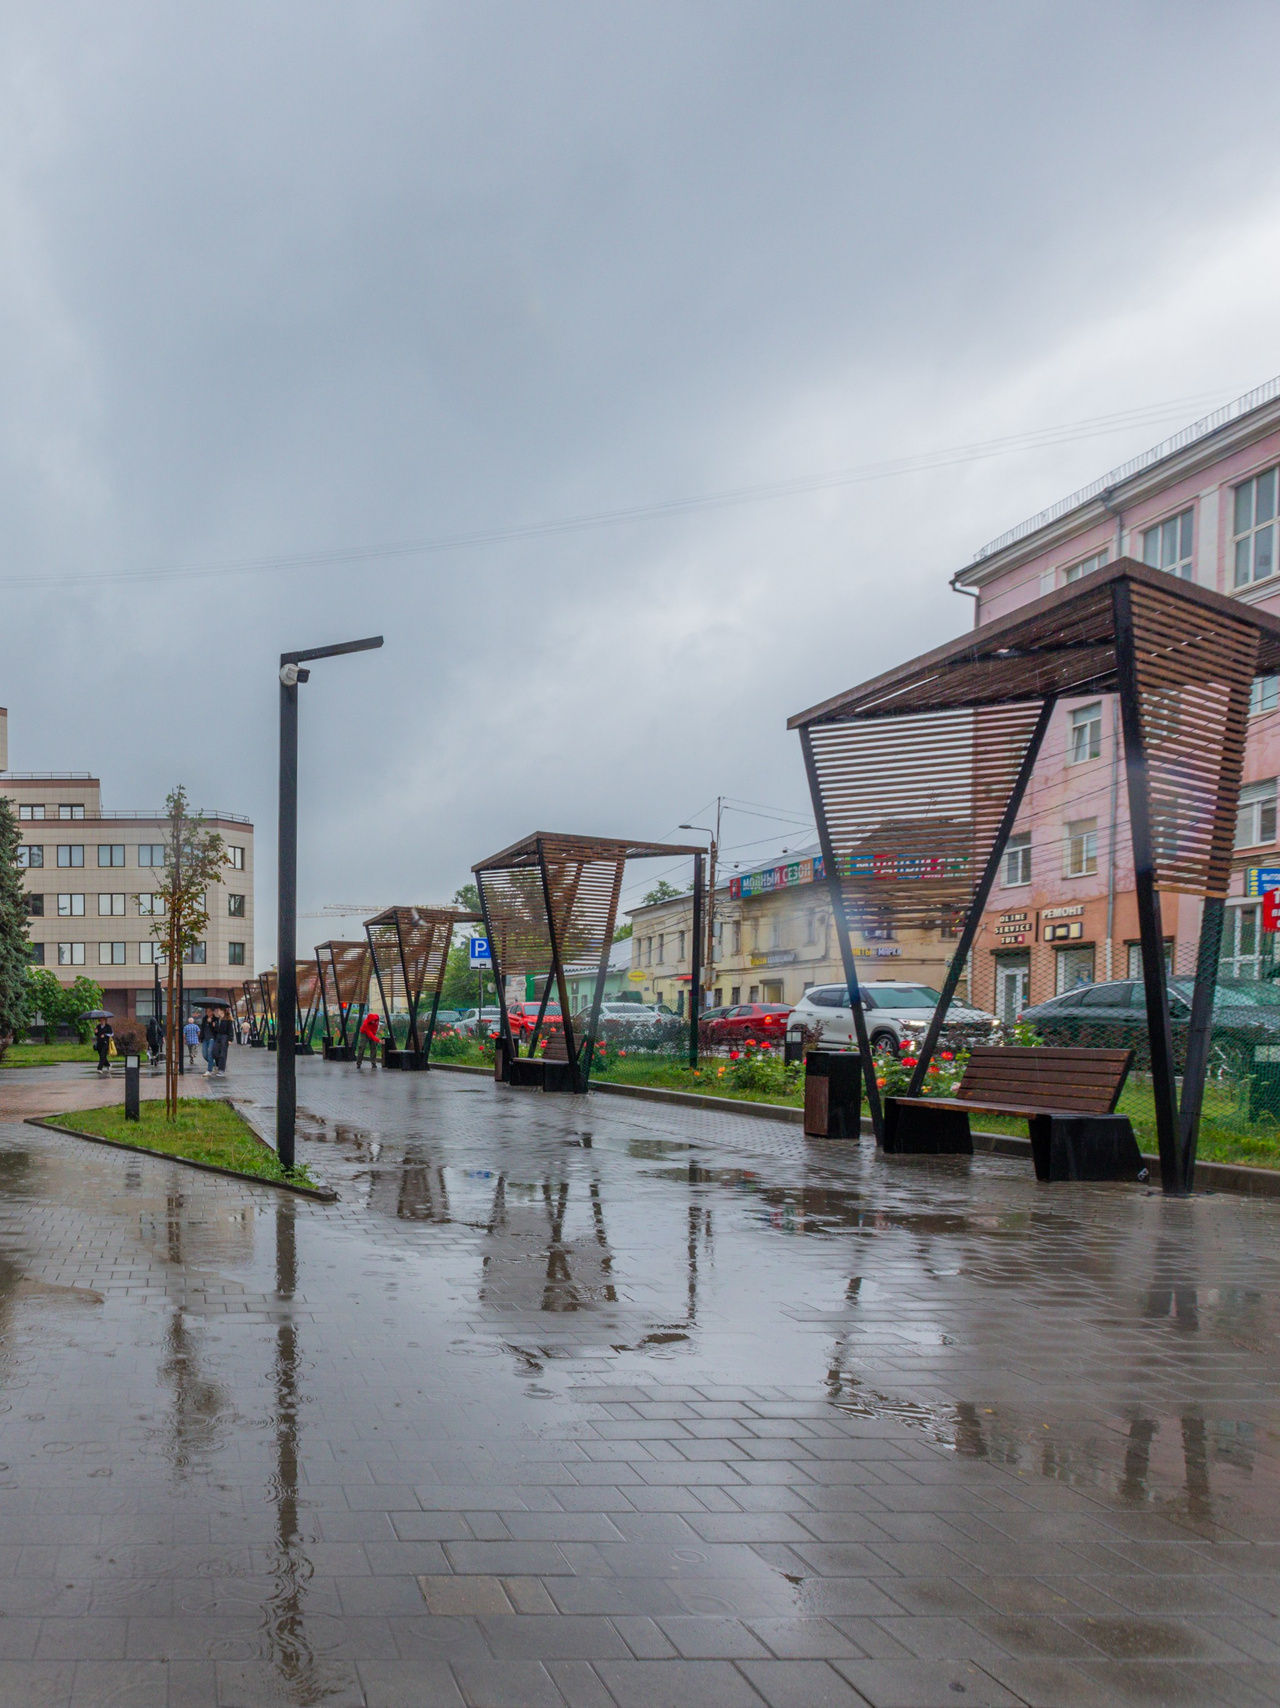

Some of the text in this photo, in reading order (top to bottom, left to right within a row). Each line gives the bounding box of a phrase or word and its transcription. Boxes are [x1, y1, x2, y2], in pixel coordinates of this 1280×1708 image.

[743, 861, 811, 891] МОДНЫЙ СЕЗОН
[1042, 905, 1084, 919] РЕМОНТ
[994, 923, 1031, 934] SERVICE
[878, 947, 902, 956] МАРКИ
